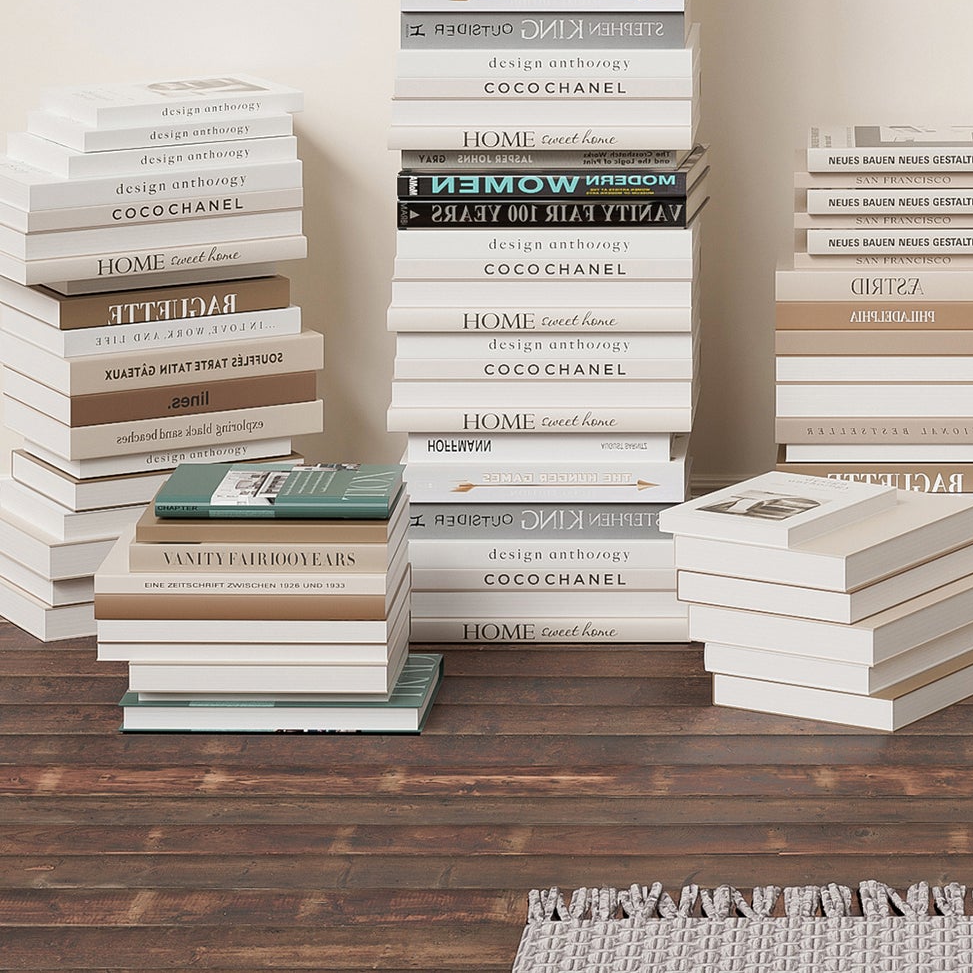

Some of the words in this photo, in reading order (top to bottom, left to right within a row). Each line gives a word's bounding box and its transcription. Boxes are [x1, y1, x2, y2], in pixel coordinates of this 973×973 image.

[488, 57, 542, 72] design
[484, 82, 540, 94] COCO
[544, 82, 626, 94] CHANEL
[162, 106, 200, 117] design
[150, 129, 188, 140] design
[463, 131, 536, 148] HOME
[541, 132, 580, 145] sweet
[580, 129, 618, 145] home
[140, 154, 183, 166] design
[828, 155, 860, 165] NEUES
[862, 155, 895, 165] BAUEN
[898, 155, 930, 165] NEUES
[116, 181, 166, 195] design
[112, 204, 163, 220] COCO
[169, 198, 244, 215] CHANEL
[828, 198, 860, 207] NEUES
[862, 198, 895, 207] BAUEN
[898, 198, 930, 207] NEUES
[488, 239, 542, 253] design
[828, 238, 860, 247] NEUES
[862, 238, 895, 247] BAUEN
[898, 238, 930, 247] NEUES
[98, 254, 166, 276] HOME
[171, 250, 206, 266] sweet
[207, 247, 242, 261] home
[484, 264, 540, 276] COCO
[544, 264, 626, 276] CHANEL
[463, 313, 536, 330] HOME
[541, 314, 580, 327] sweet
[580, 311, 618, 327] home
[488, 339, 542, 353] design
[484, 364, 540, 376] COCO
[544, 364, 626, 376] CHANEL
[463, 414, 536, 431] HOME
[541, 415, 580, 428] sweet
[580, 412, 618, 428] home
[146, 452, 185, 464] design
[163, 552, 225, 566] VANITY
[301, 552, 356, 566] YEARS
[488, 548, 542, 562] design
[484, 574, 540, 586] COCO
[544, 574, 626, 586] CHANEL
[463, 624, 536, 641] HOME
[541, 625, 580, 638] sweet
[580, 622, 618, 638] home
